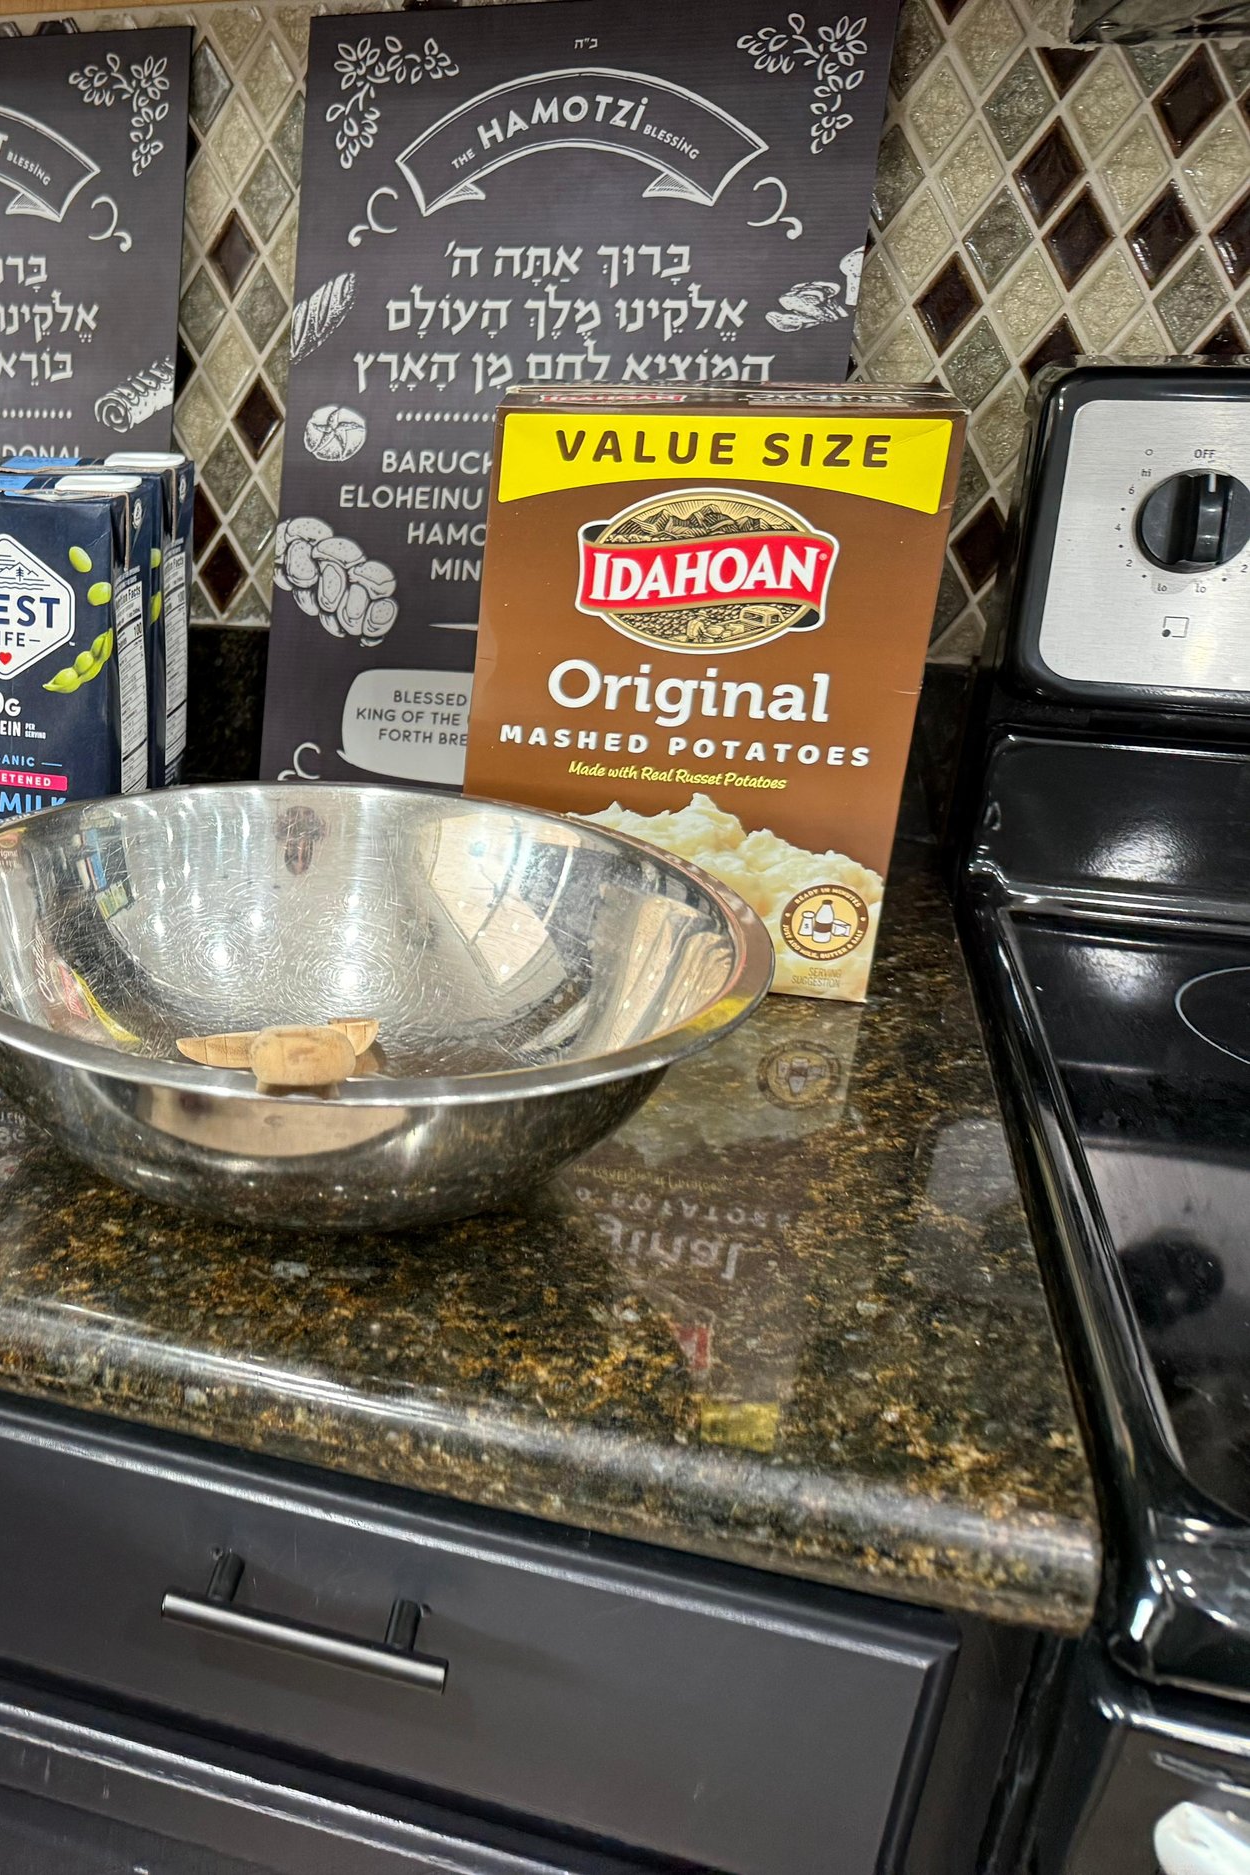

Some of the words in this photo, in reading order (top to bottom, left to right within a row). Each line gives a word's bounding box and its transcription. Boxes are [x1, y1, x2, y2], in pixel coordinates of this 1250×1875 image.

[451, 148, 475, 169] THE
[556, 429, 736, 464] VALUE
[762, 432, 891, 467] SIZE
[1193, 449, 1216, 459] OFF
[339, 485, 482, 510] ELOHEINU
[431, 558, 481, 582] MIN
[590, 546, 820, 601] IDAHOAN
[393, 690, 467, 706] BLESSED
[548, 659, 829, 726] Original
[25, 723, 36, 731] PER
[356, 708, 395, 721] KING
[401, 710, 424, 723] OF
[431, 712, 460, 726] THE
[378, 728, 432, 743] FORTH
[499, 724, 647, 753] MASHED
[668, 737, 869, 766] POTATOES
[568, 761, 605, 776] Made
[607, 765, 637, 779] with
[640, 766, 674, 781] Real
[675, 768, 722, 785] Russet
[723, 772, 787, 789] Potatoes
[791, 975, 840, 988] SUGGESTION
